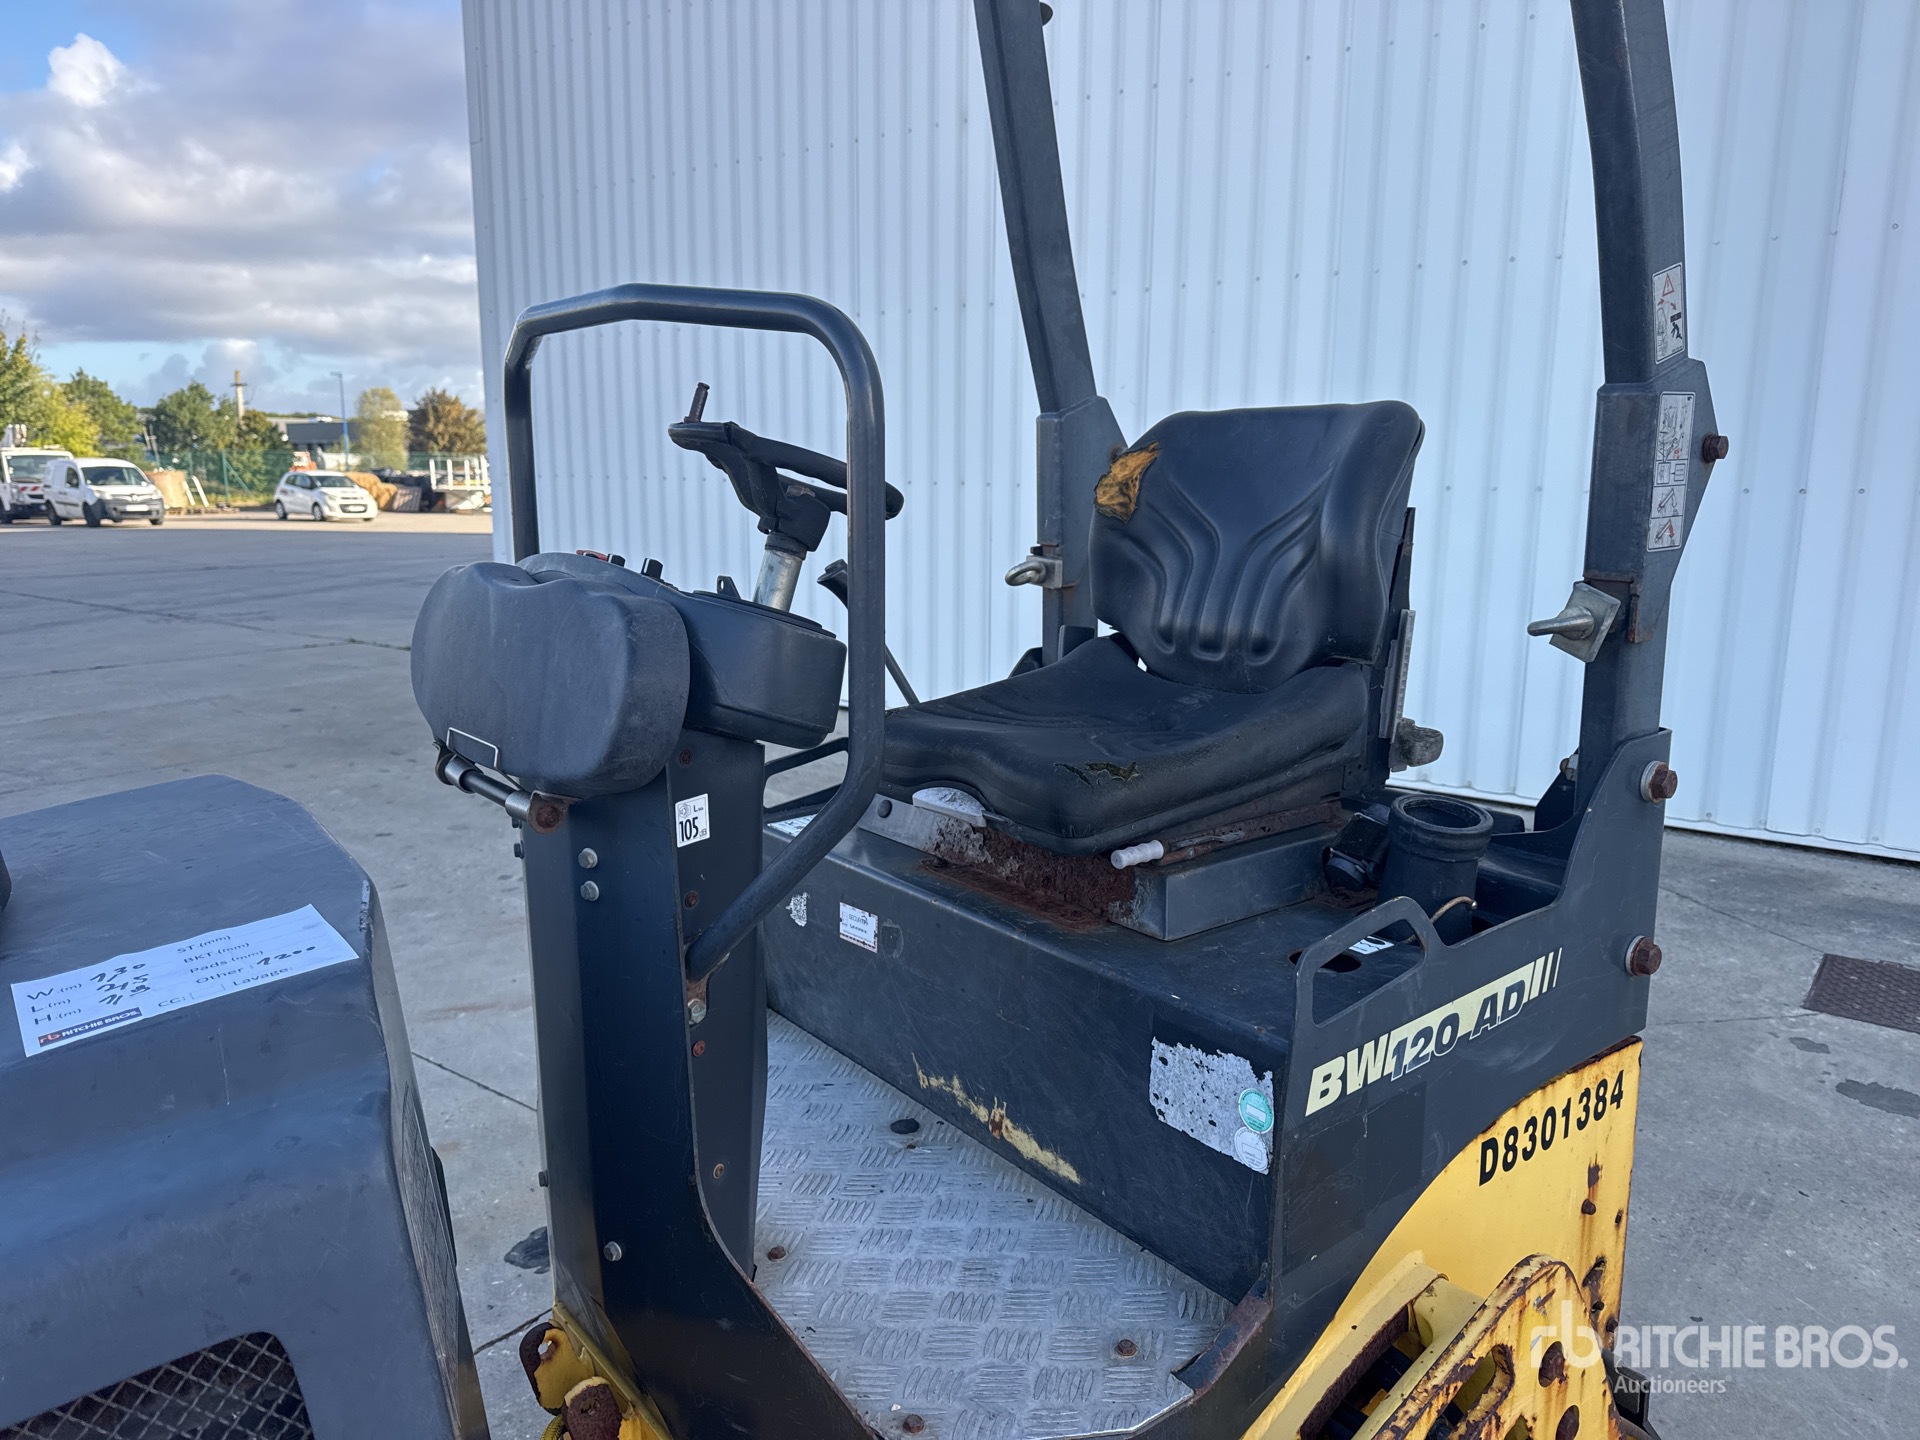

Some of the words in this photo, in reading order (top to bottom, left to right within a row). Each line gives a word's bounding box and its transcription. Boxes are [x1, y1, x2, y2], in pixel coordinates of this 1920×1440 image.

[679, 816, 699, 842] 105
[1469, 979, 1528, 1041] AD
[1479, 1069, 1625, 1187] D8301384
